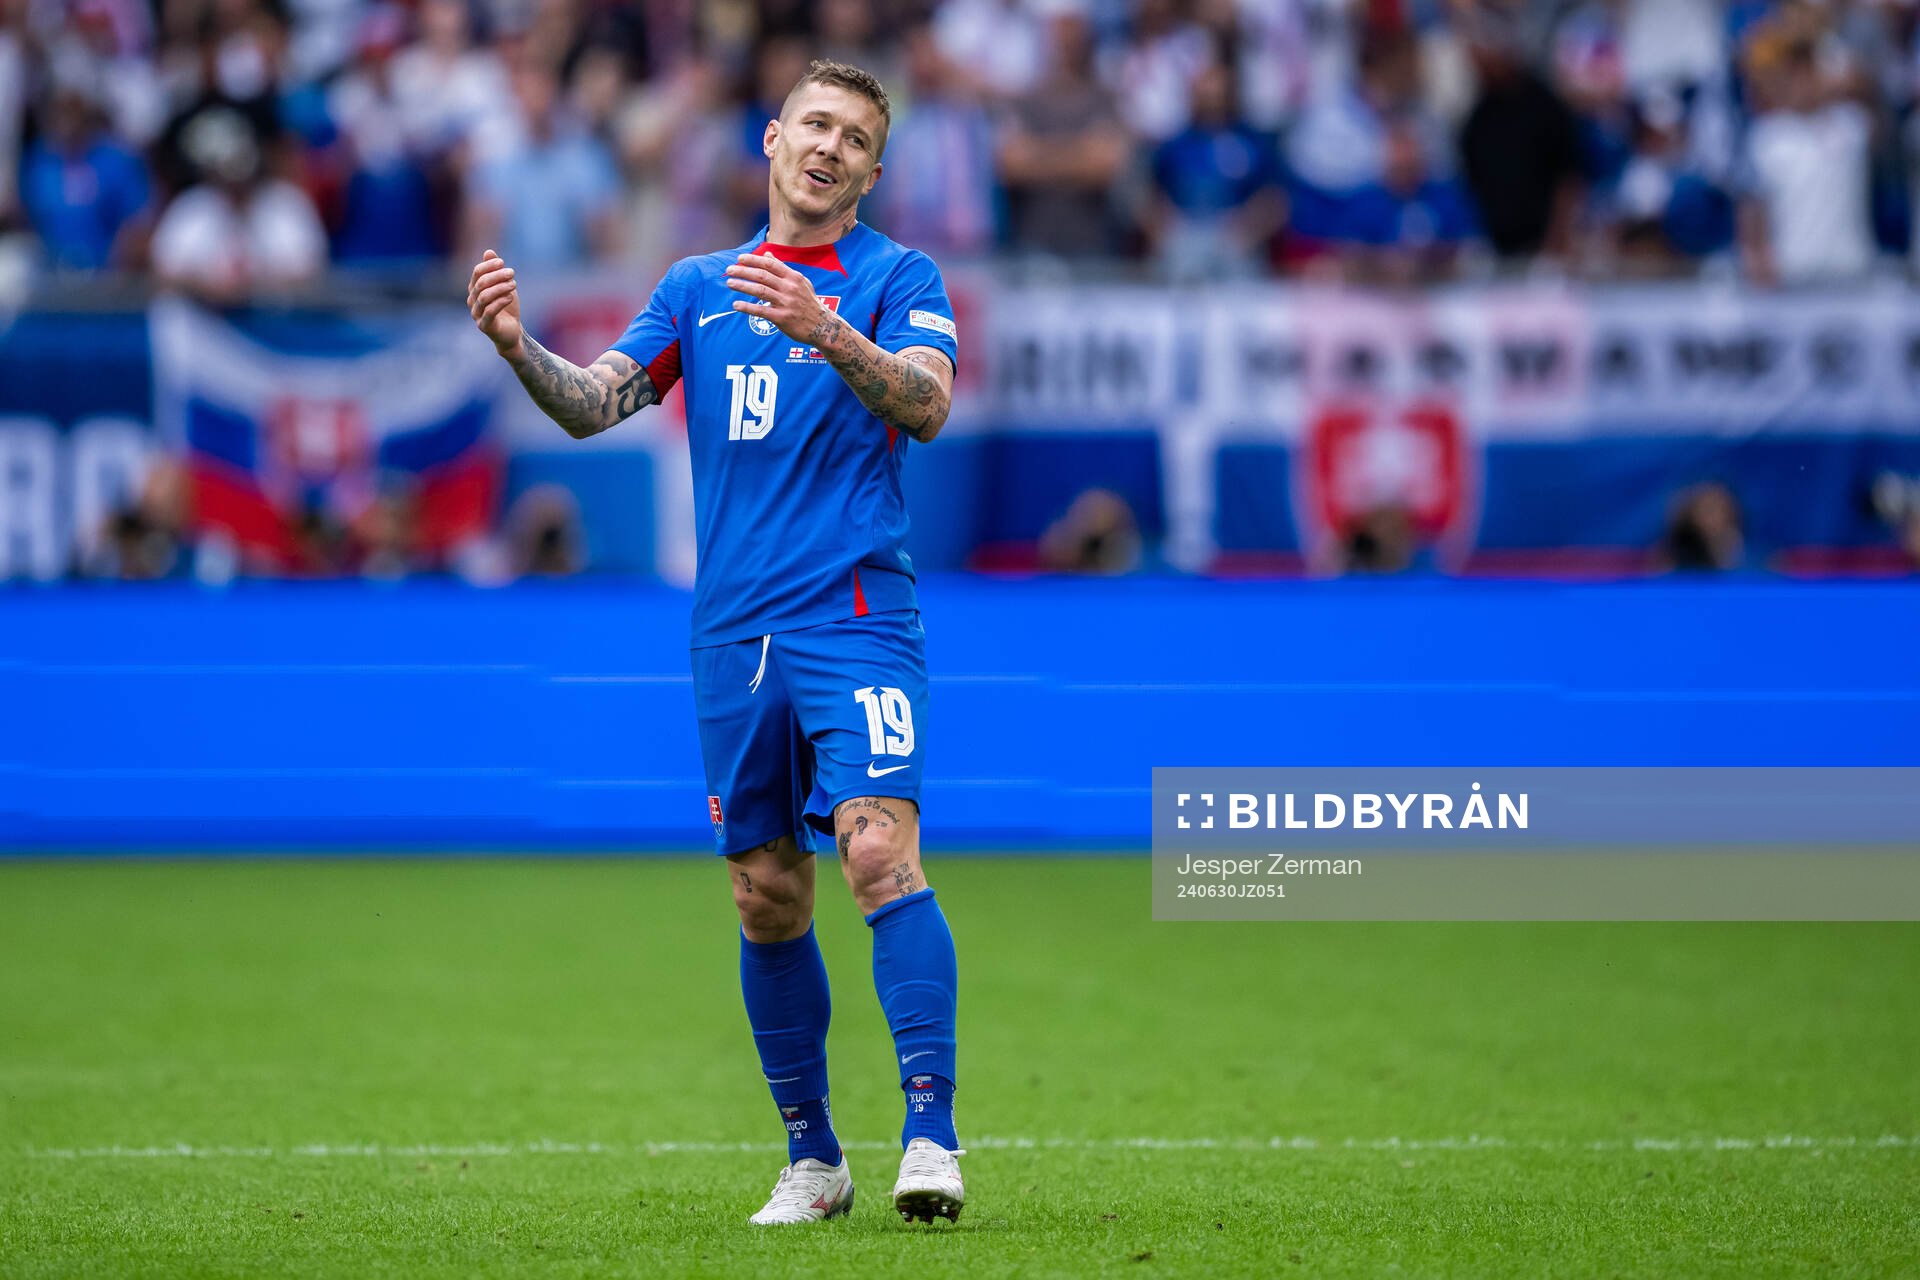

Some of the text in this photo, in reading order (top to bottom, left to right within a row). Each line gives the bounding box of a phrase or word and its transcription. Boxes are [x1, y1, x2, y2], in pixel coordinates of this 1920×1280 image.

[726, 364, 778, 441] 19
[854, 686, 915, 757] 19
[914, 1103, 924, 1113] 19
